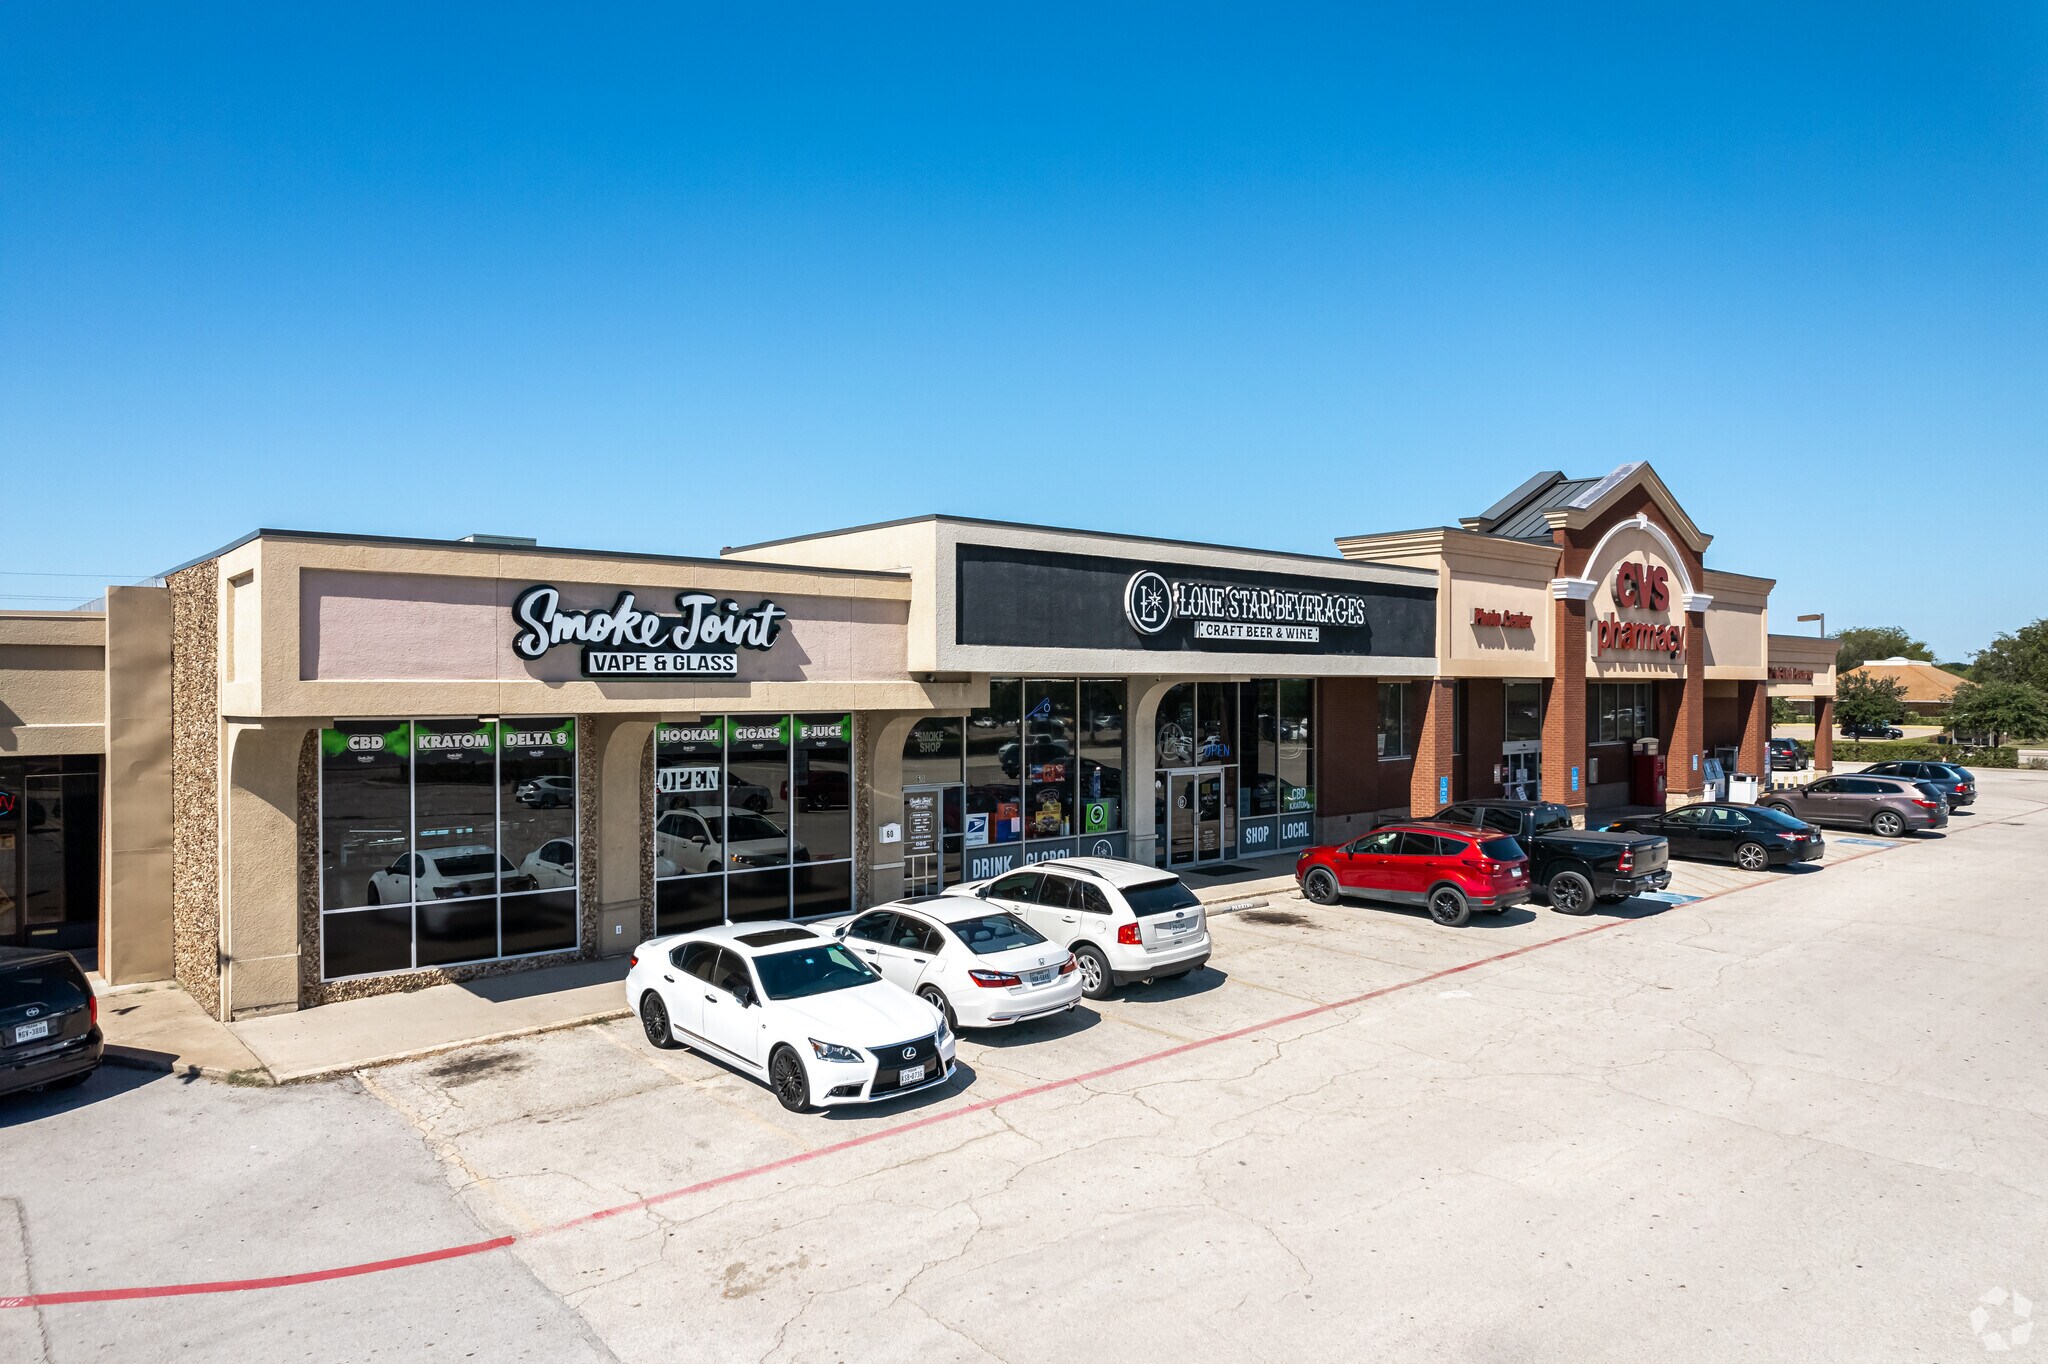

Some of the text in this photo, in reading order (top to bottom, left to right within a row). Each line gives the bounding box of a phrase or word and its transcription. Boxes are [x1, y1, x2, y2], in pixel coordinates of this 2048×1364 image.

[1616, 561, 1669, 611] CVS
[1179, 585, 1366, 625] LONE STAR BEVERAGES
[520, 588, 787, 656] Smoke Joint
[1474, 608, 1532, 629] Photo Center
[1206, 624, 1313, 640] CRAFT BEER & WINE
[1597, 612, 1685, 660] pharmacy
[593, 654, 734, 671] VAPE & GLASS
[505, 732, 567, 747] DELTA 8
[659, 729, 719, 742] HOOKAH
[735, 727, 781, 740] CIGARS
[801, 726, 842, 738] E-JUICE
[917, 731, 944, 742] SMOKE
[348, 735, 384, 750] CBD
[418, 733, 490, 750] KRATOM
[919, 742, 941, 753] SHOP
[1204, 744, 1230, 757] OPEN
[658, 767, 719, 793] OPEN
[1291, 787, 1306, 800] CBD
[886, 830, 894, 839] 60
[1246, 825, 1269, 844] SHOP
[1282, 821, 1309, 840] LOCAL
[972, 855, 1013, 879] DRINK
